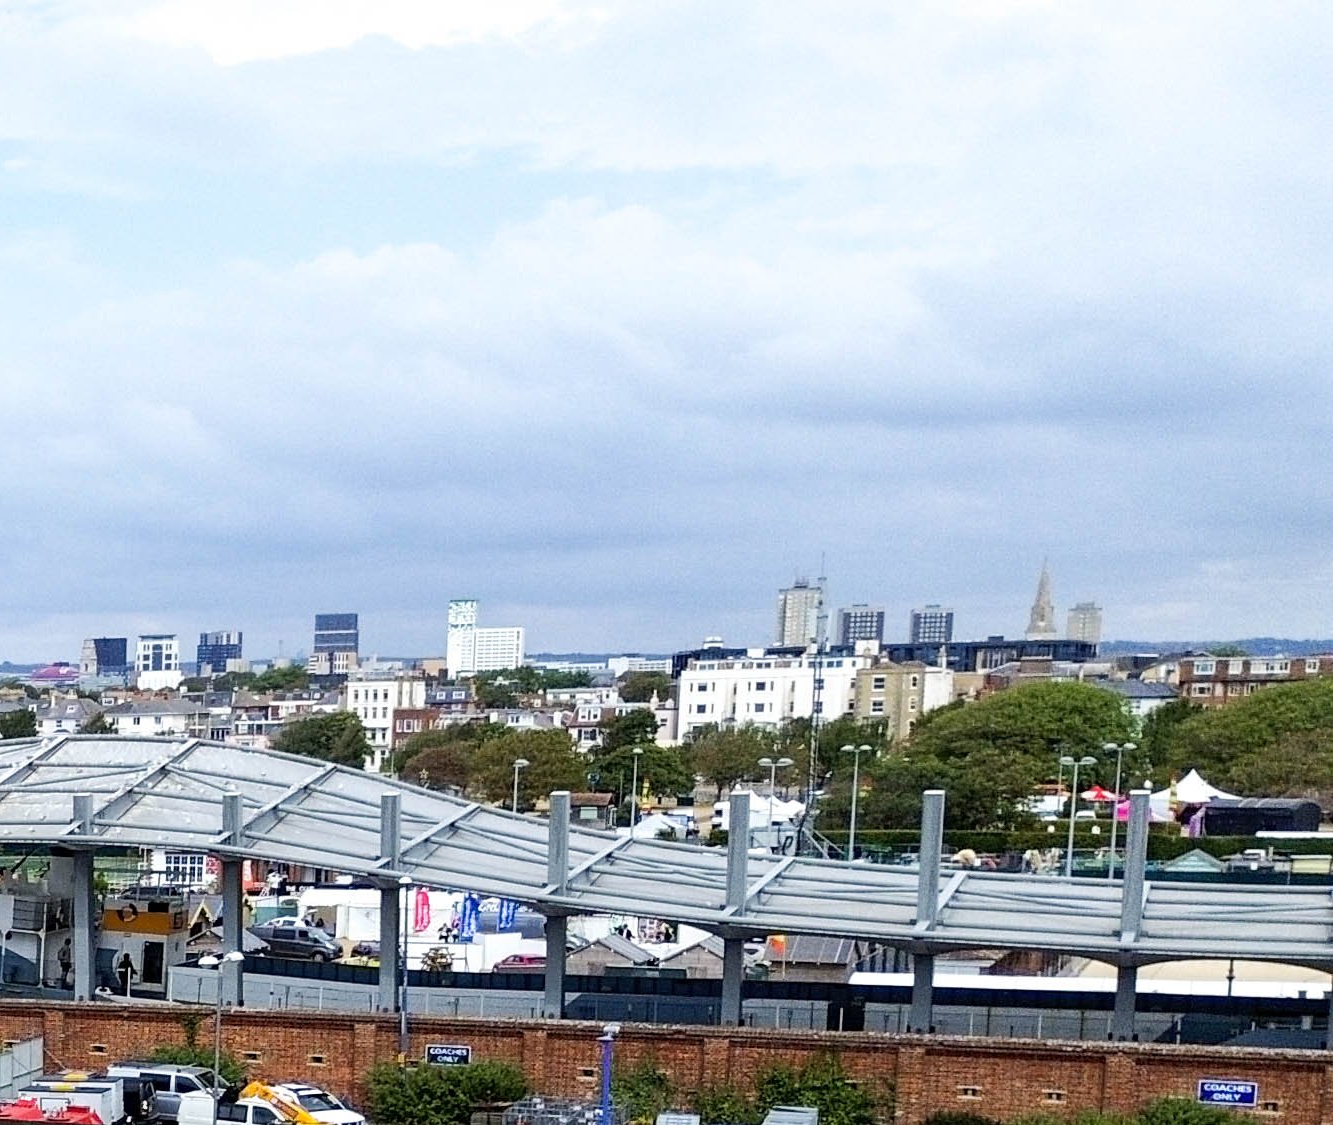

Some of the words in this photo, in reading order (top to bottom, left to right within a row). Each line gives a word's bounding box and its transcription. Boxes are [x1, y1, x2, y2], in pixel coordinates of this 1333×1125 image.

[429, 1047, 467, 1056] COACHES
[437, 1055, 459, 1063] ONLY
[1203, 1083, 1253, 1094] COACHES
[1212, 1092, 1242, 1101] ONLY
